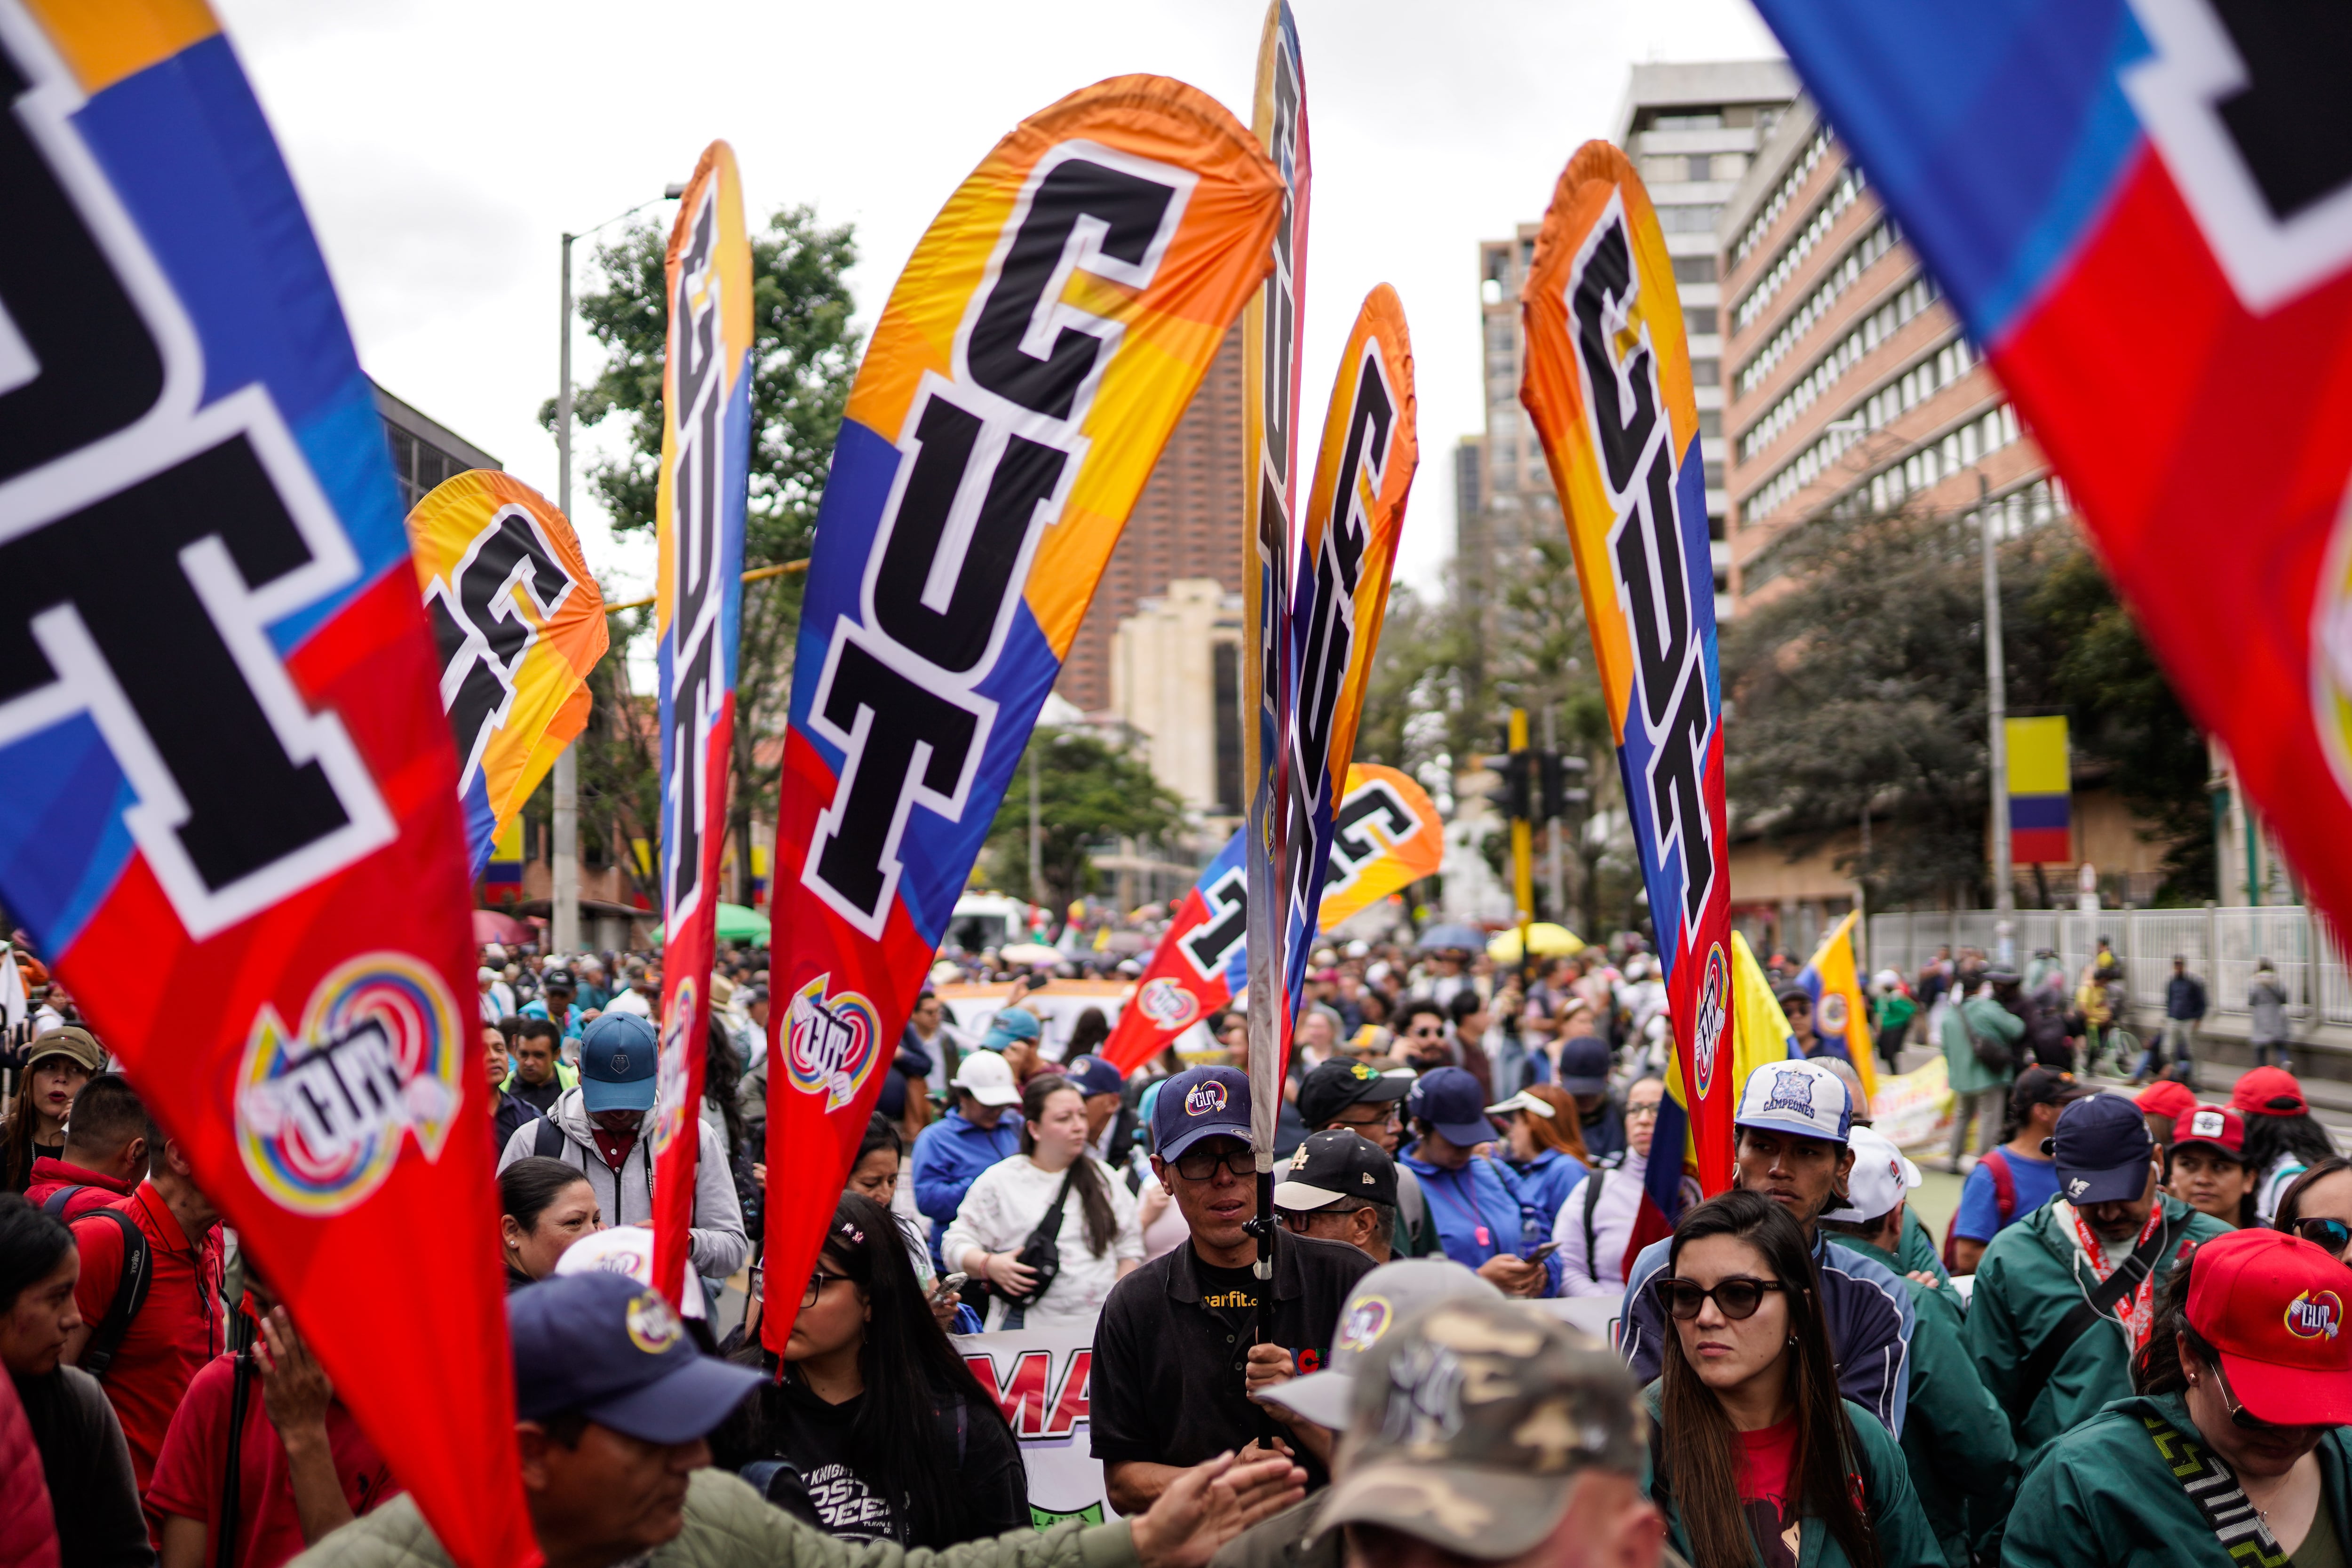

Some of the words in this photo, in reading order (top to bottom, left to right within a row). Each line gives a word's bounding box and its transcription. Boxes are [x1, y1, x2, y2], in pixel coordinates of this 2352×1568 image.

[807, 147, 1192, 932] CUT
[1570, 200, 1715, 941] CUT
[1195, 1090, 1216, 1108] CUT
[1763, 1098, 1816, 1119] CAMPEONES
[2301, 1303, 2330, 1328] CUT
